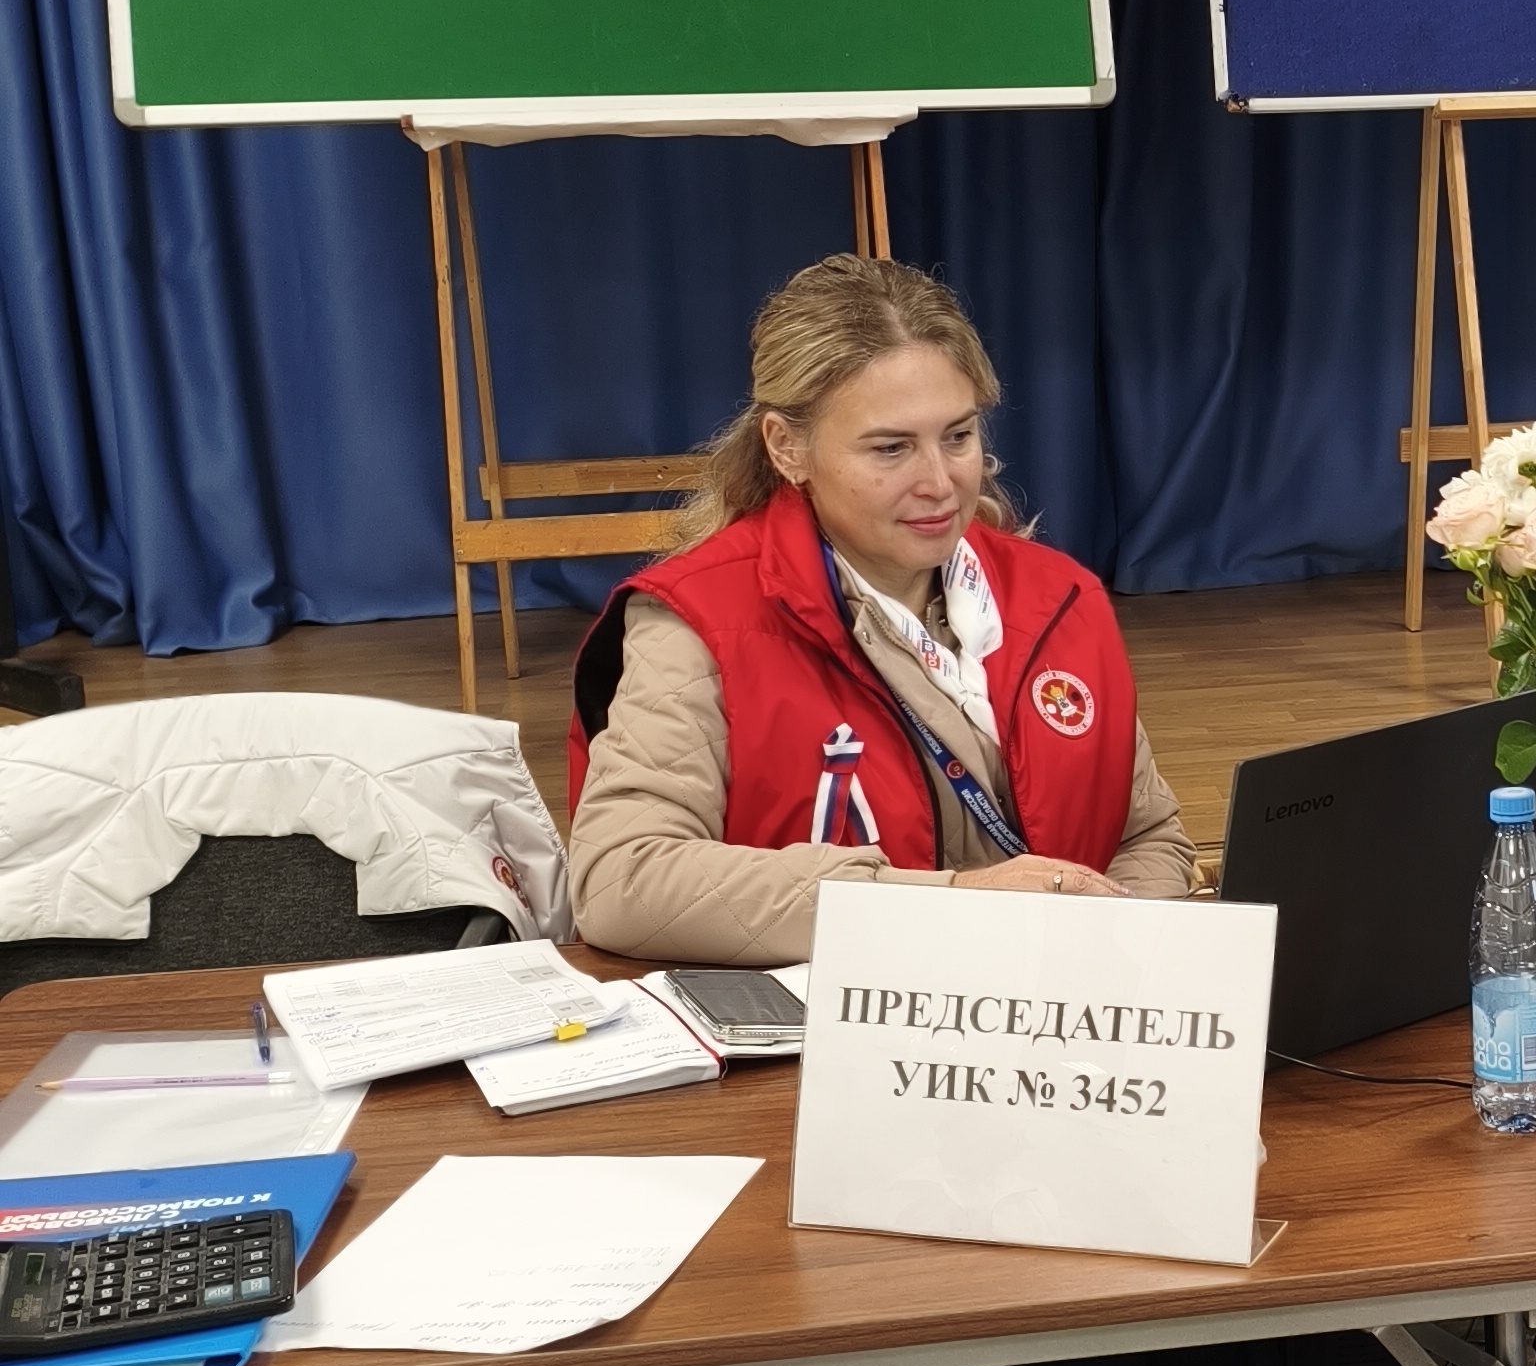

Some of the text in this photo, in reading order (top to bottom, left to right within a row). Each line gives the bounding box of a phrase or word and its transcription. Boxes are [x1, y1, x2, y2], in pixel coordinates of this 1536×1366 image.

[961, 788, 991, 825] КОМИССИЯ
[974, 791, 999, 822] ОБЛАСТИ
[1265, 794, 1334, 823] Lenovo
[837, 986, 1236, 1051] ПРЕДСЕДАТЕЛЬ
[890, 1059, 1168, 1117] УИК № 3452
[1, 1192, 272, 1224] К ПОДМОСКОВЬЮ!
[160, 1210, 180, 1220] С
